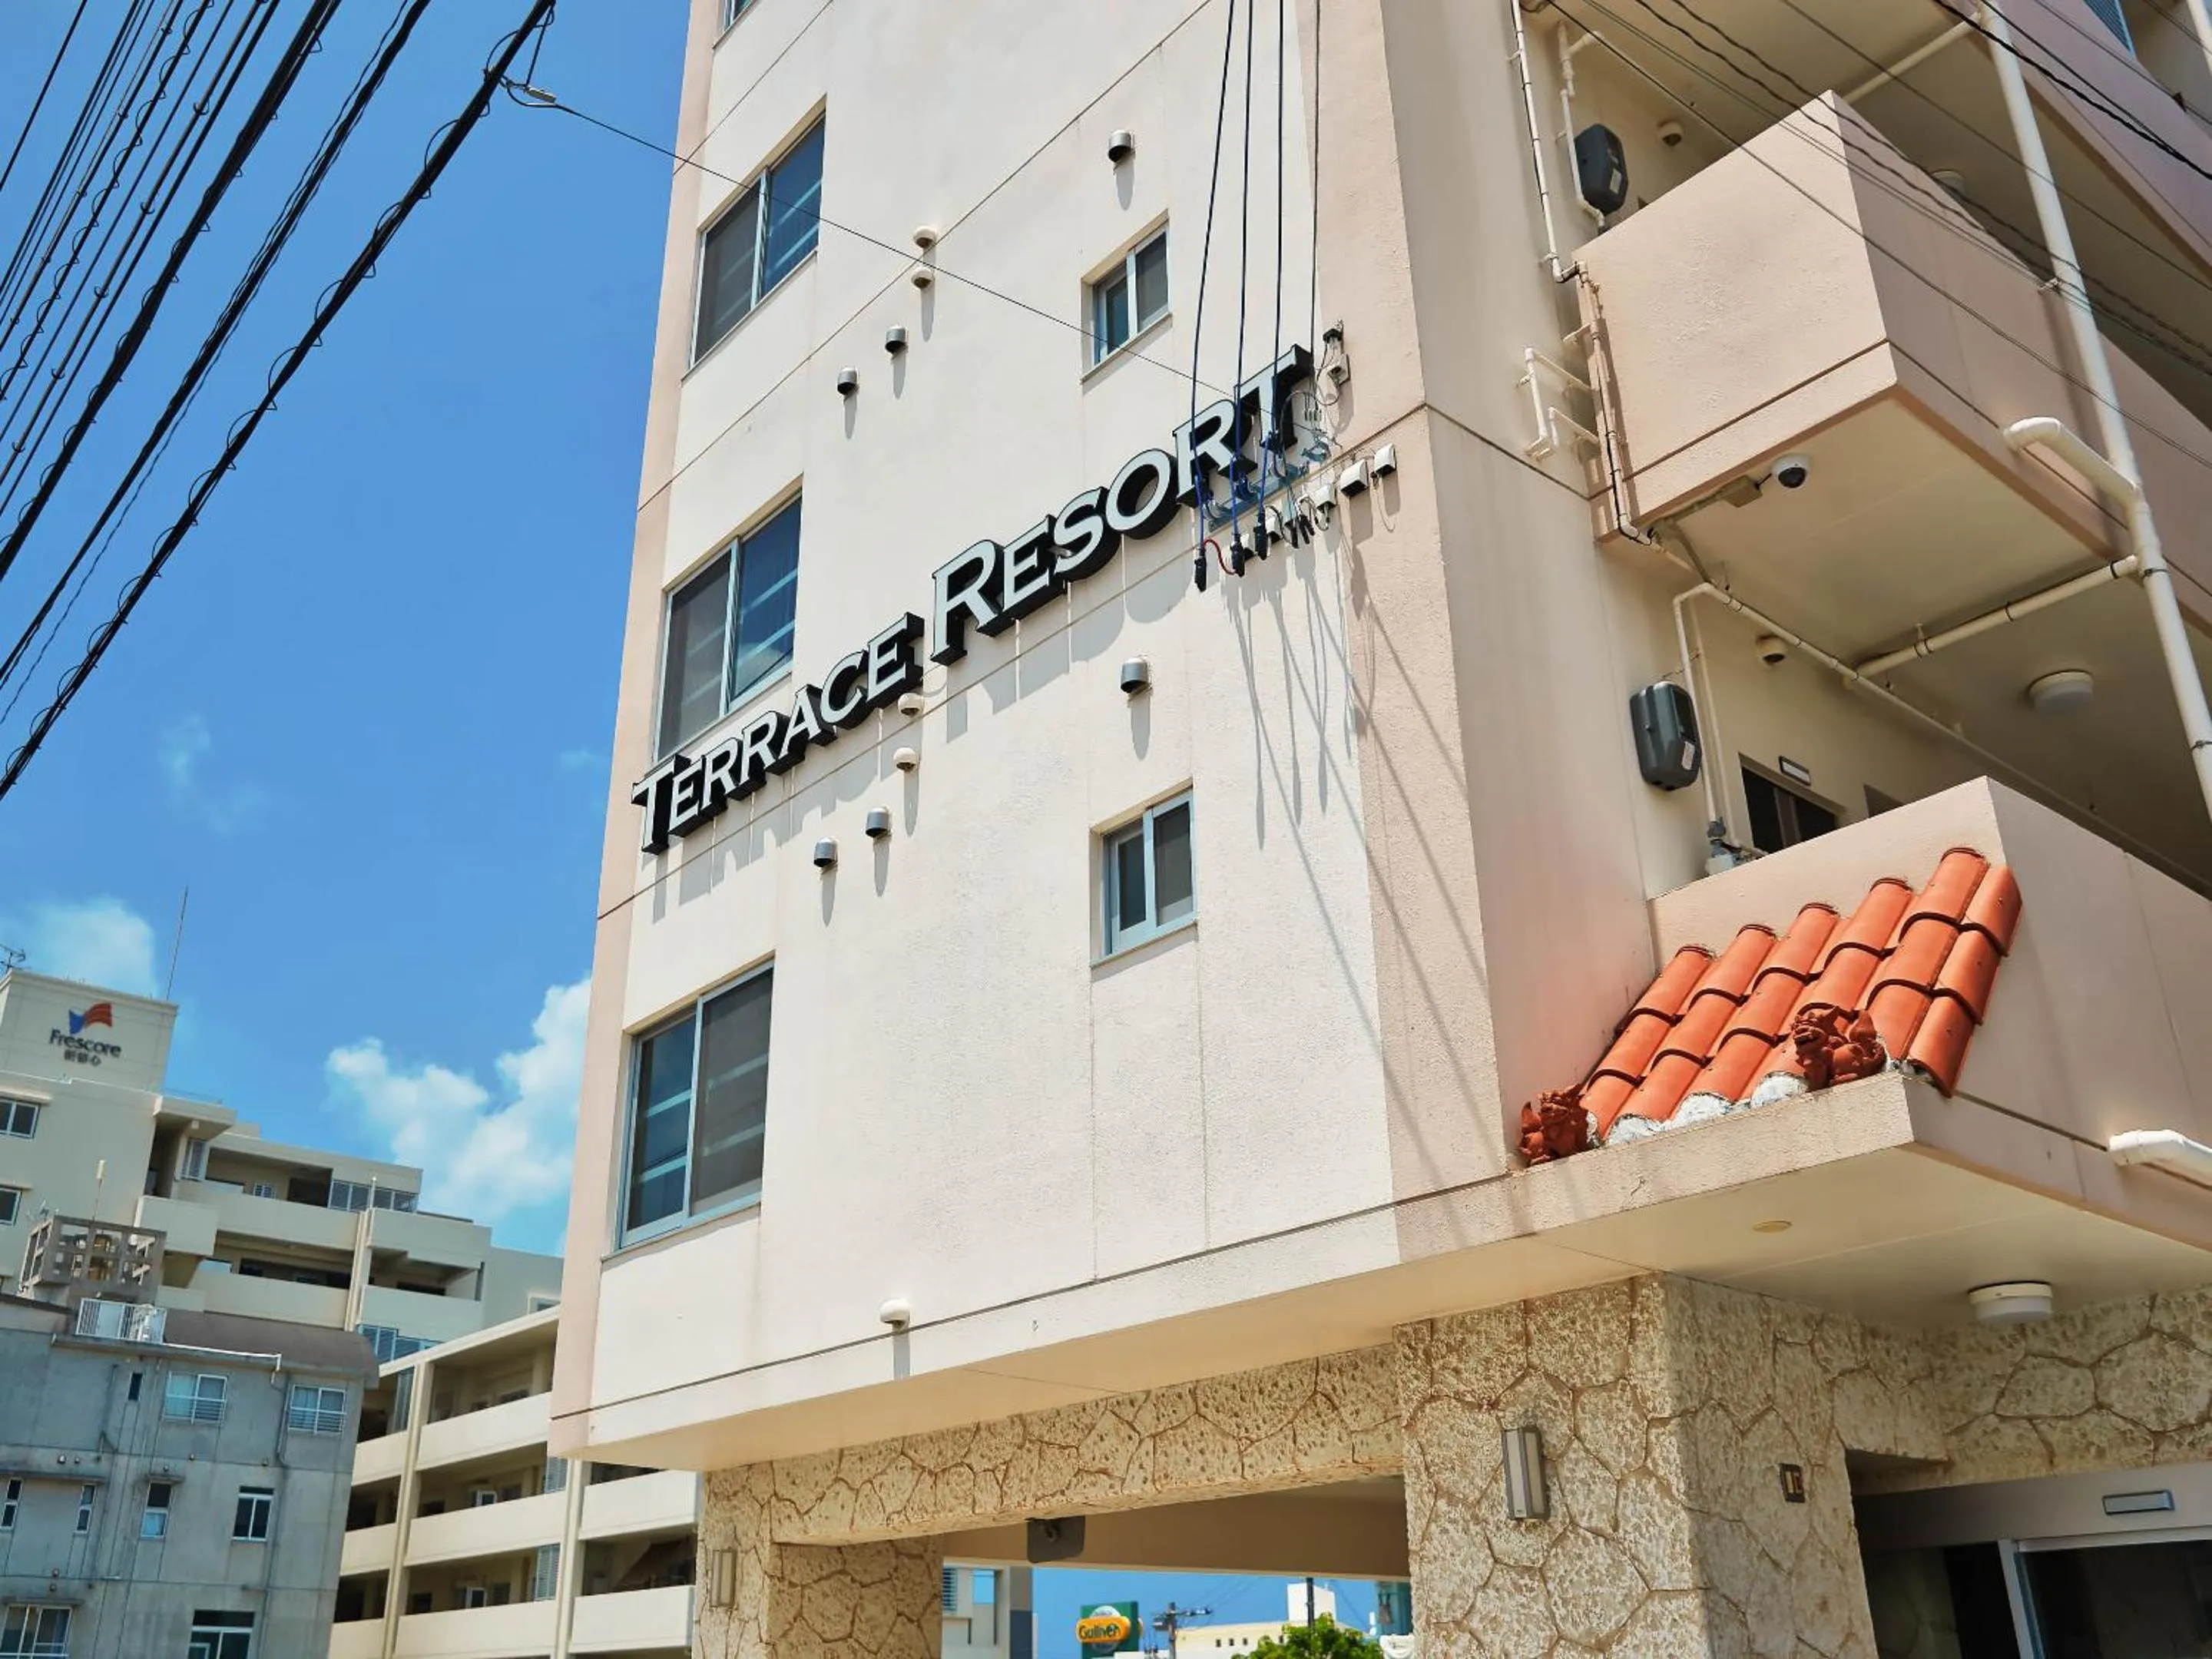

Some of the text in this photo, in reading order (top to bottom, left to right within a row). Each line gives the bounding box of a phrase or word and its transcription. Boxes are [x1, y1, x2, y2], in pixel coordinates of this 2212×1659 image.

[631, 344, 1314, 854] TERRACE RESORT
[48, 1028, 122, 1058] Frescore
